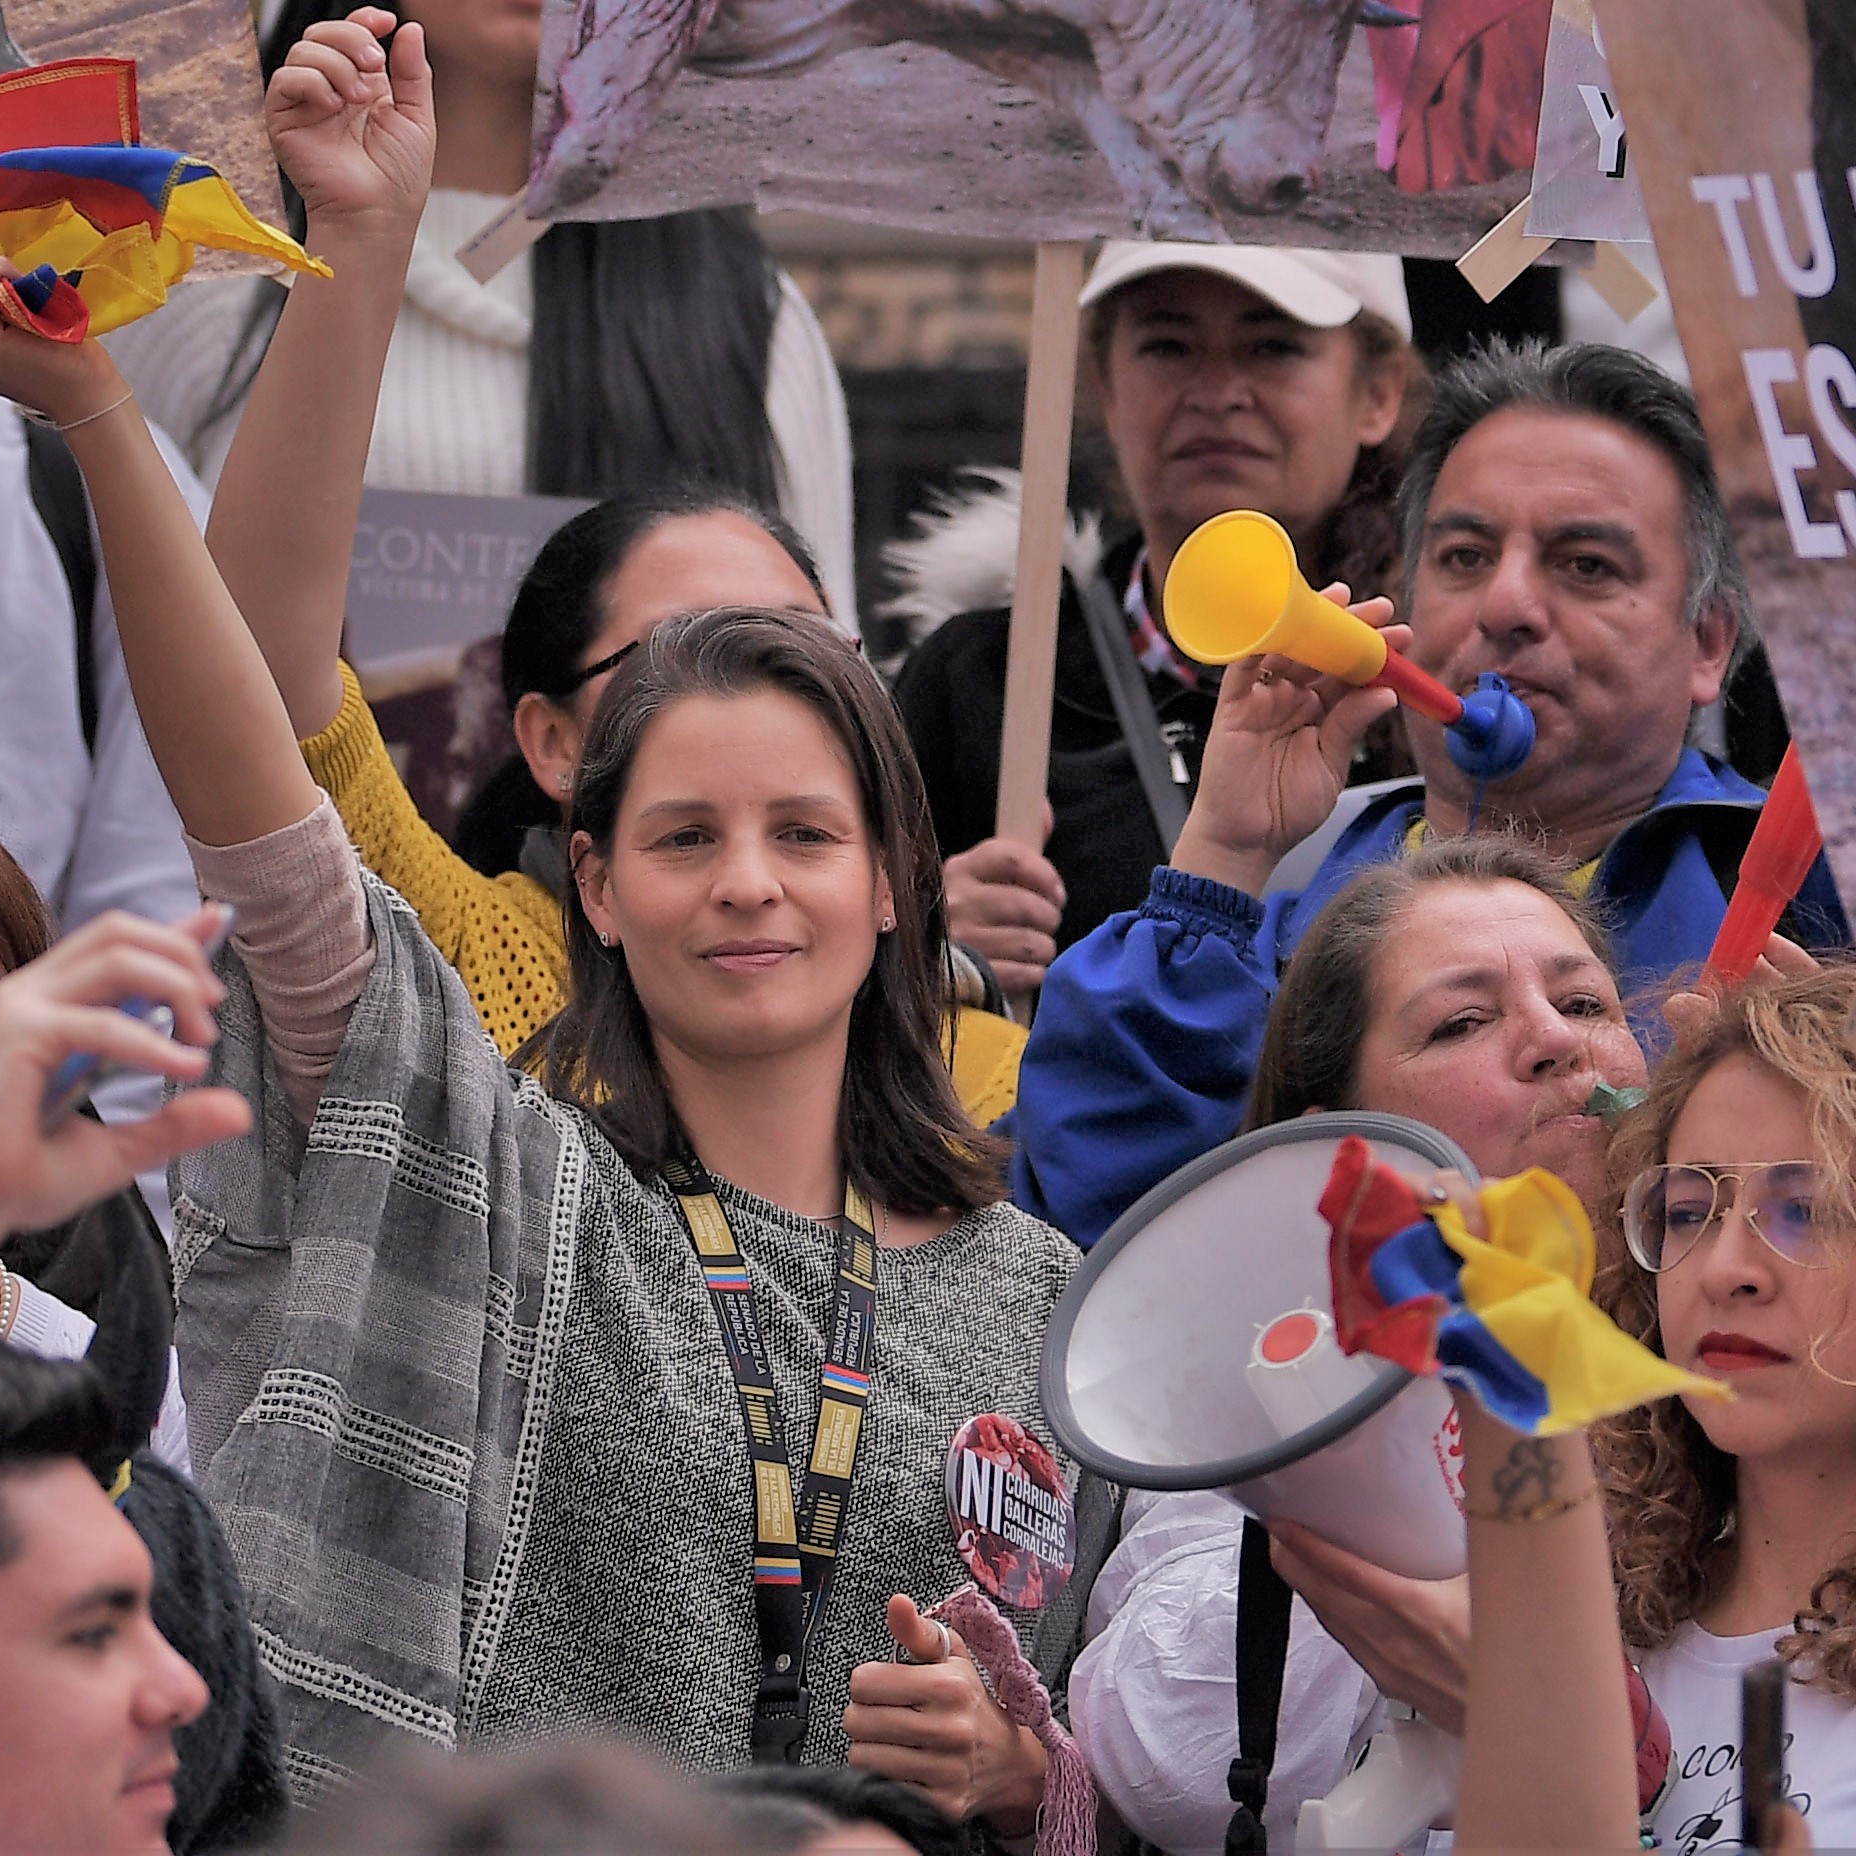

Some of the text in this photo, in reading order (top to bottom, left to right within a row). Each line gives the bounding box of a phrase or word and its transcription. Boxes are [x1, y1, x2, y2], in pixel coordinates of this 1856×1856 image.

[1577, 84, 1627, 178] Y
[1689, 173, 1840, 300] TU
[736, 1293, 768, 1376] SENADO DE LA
[831, 1289, 851, 1363] SENADO DE LA
[960, 1447, 1004, 1535] NI
[1003, 1495, 1067, 1549] GALLERAS
[1004, 1470, 1067, 1525] CORRIDAS
[1002, 1520, 1066, 1571] CORRALEJAS
